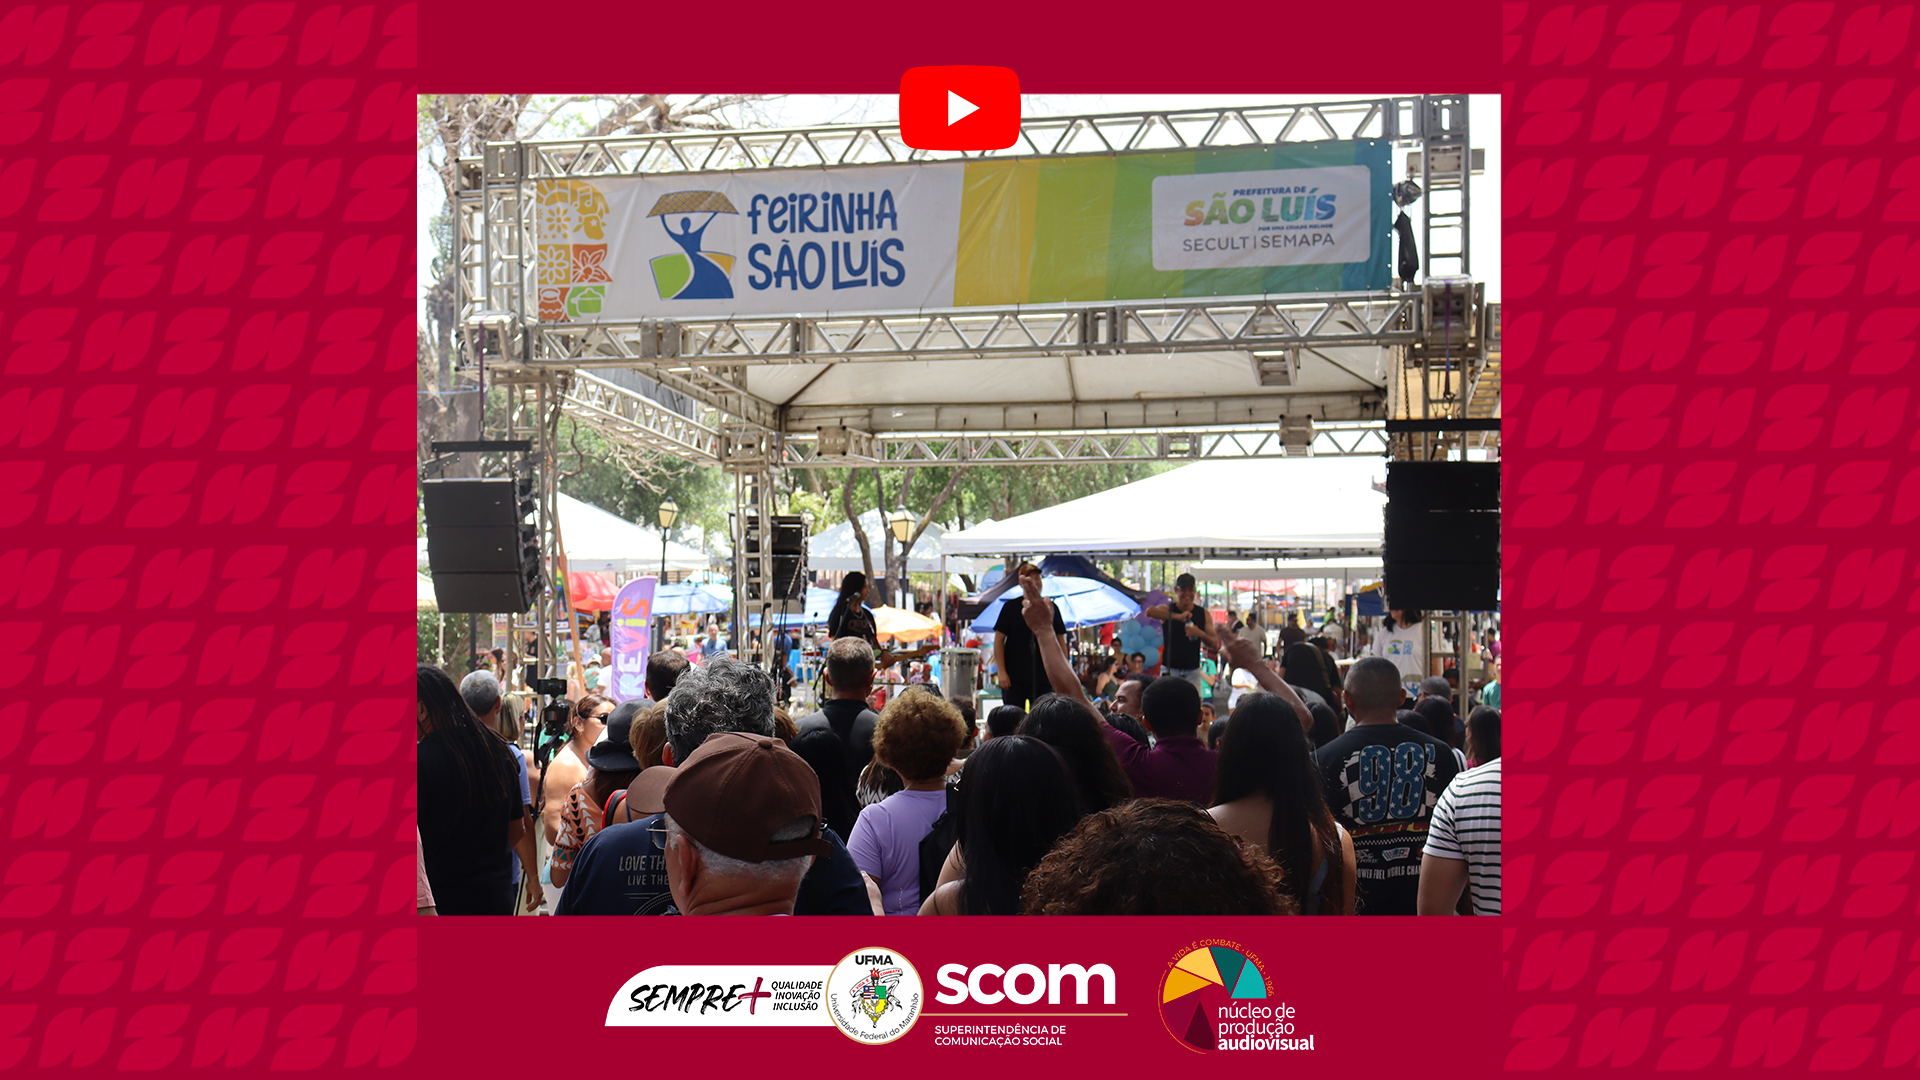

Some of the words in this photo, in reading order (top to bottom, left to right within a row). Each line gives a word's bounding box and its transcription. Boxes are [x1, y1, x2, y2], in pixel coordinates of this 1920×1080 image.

[1233, 187, 1291, 196] PREFEITURA
[1183, 191, 1256, 226] SÃO
[1261, 187, 1337, 223] LUÍS
[1183, 236, 1249, 252] SECULT
[1261, 233, 1335, 249] SEMAPA
[748, 239, 826, 291] SÃO
[832, 238, 906, 290] LUÍS
[619, 855, 647, 871] LOVE
[650, 855, 667, 871] TH
[627, 874, 647, 886] LIVE
[1357, 868, 1373, 879] OWER
[1373, 869, 1386, 880] FUEL
